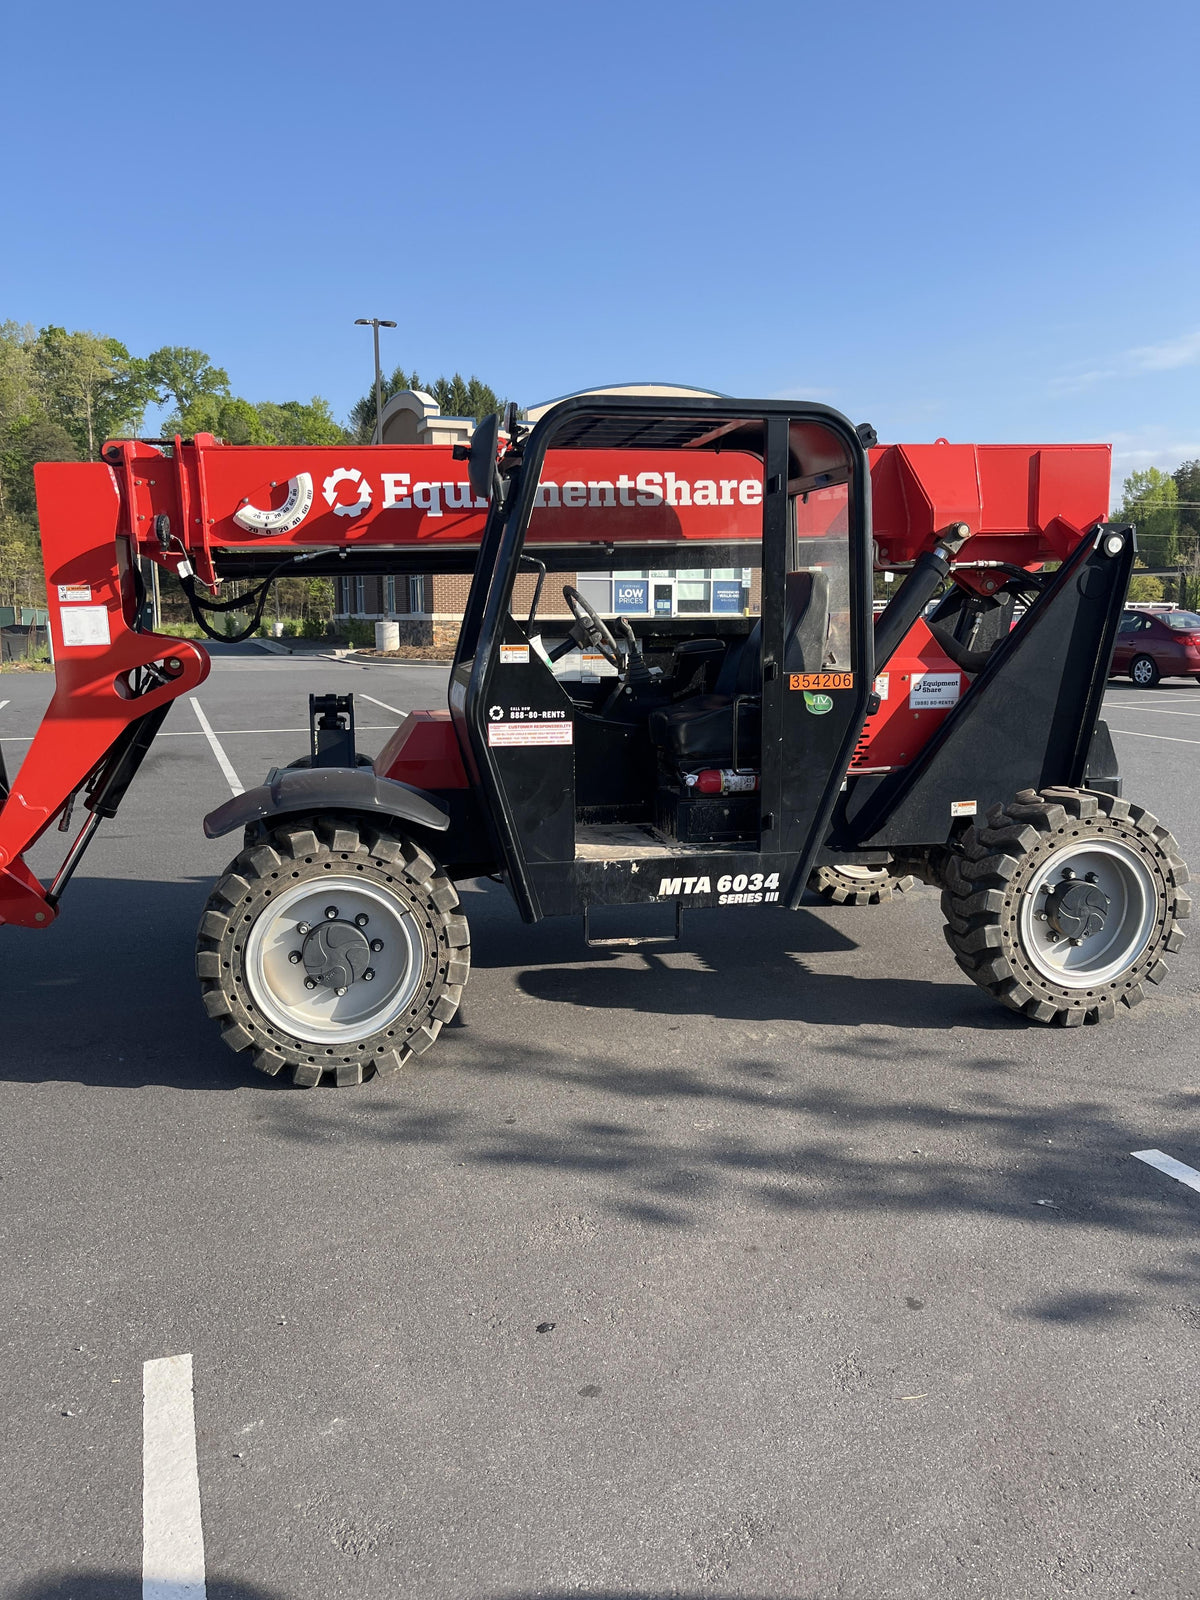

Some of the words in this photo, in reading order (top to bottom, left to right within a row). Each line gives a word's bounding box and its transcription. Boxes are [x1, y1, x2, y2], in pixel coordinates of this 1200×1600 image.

[279, 525, 289, 533] 20
[292, 517, 301, 526] 40
[302, 504, 310, 515] 60
[306, 489, 313, 500] 80
[619, 588, 644, 598] LOW
[792, 674, 851, 688] 354206
[510, 711, 566, 719] 888-80-RENTS
[659, 876, 711, 895] MTA
[716, 872, 780, 893] 6034
[718, 893, 763, 905] SERIES
[764, 891, 780, 902] III
